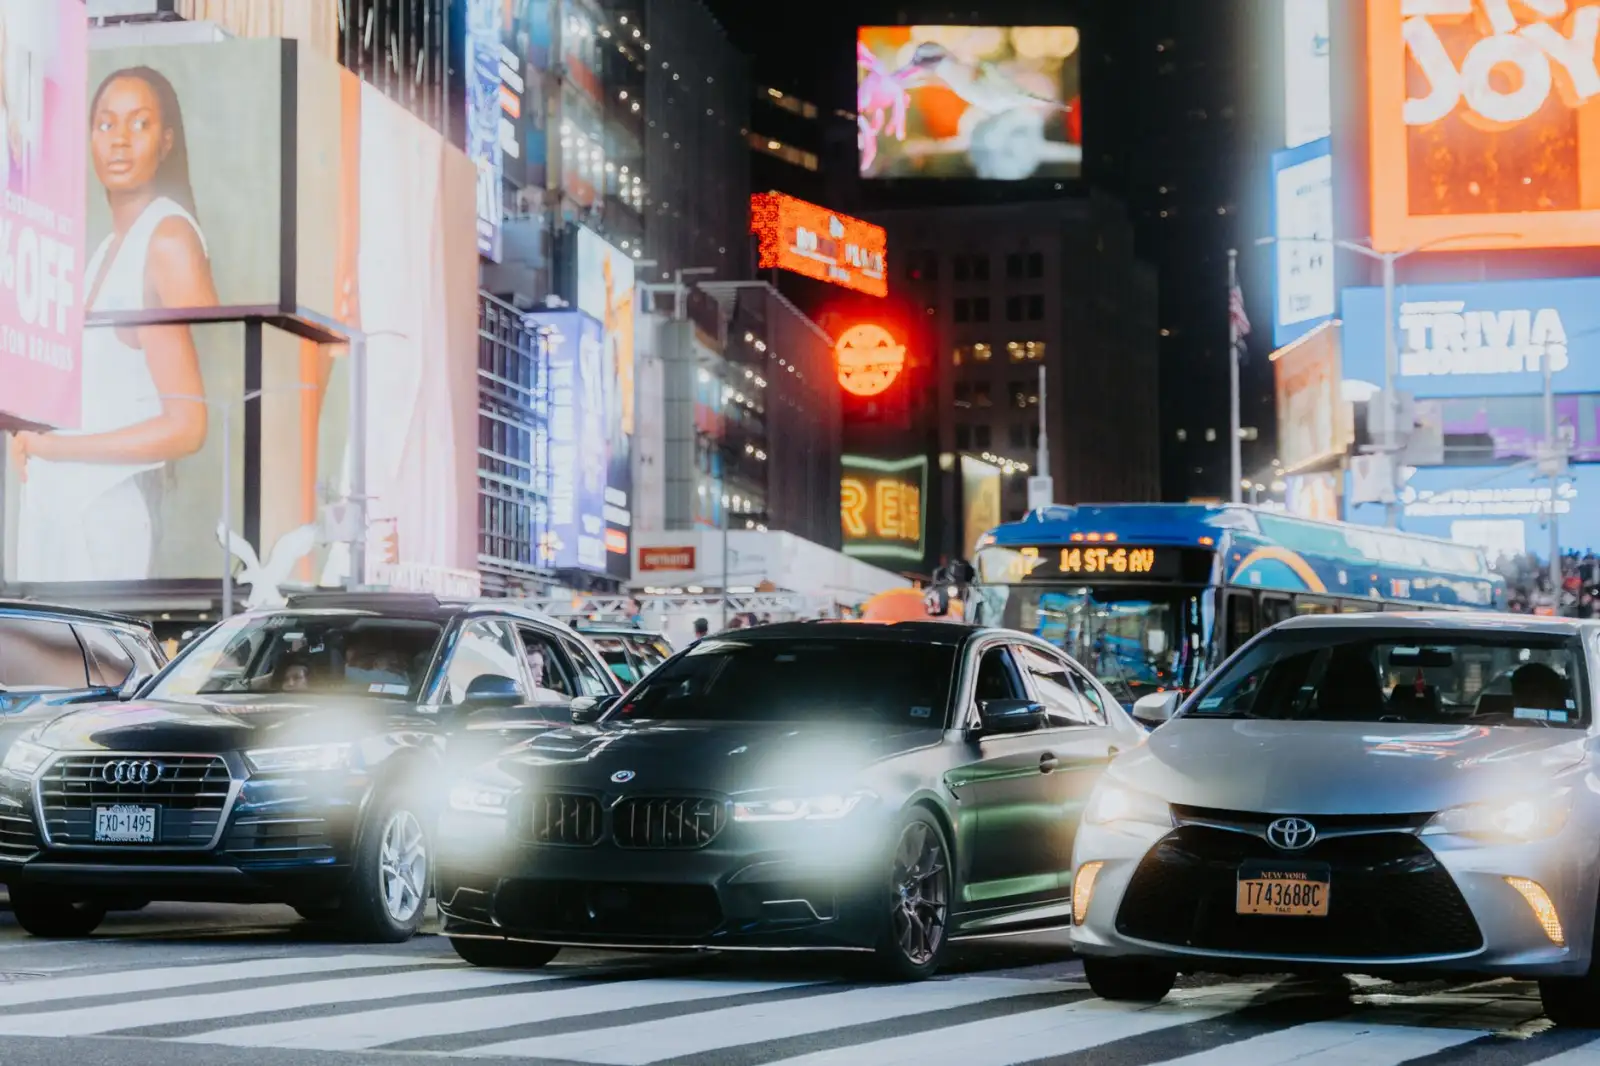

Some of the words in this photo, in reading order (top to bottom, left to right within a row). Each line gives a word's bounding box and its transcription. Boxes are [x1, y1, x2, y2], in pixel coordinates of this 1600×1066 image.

[1402, 5, 1600, 125] JOY
[16, 226, 75, 337] OFF
[1400, 309, 1567, 350] TRIVIA
[1060, 548, 1081, 572] 14
[1083, 548, 1127, 572] ST-6
[1129, 548, 1154, 572] AV
[1261, 871, 1282, 880] NEW
[1284, 871, 1308, 880] YORK
[1245, 882, 1320, 907] T743688C
